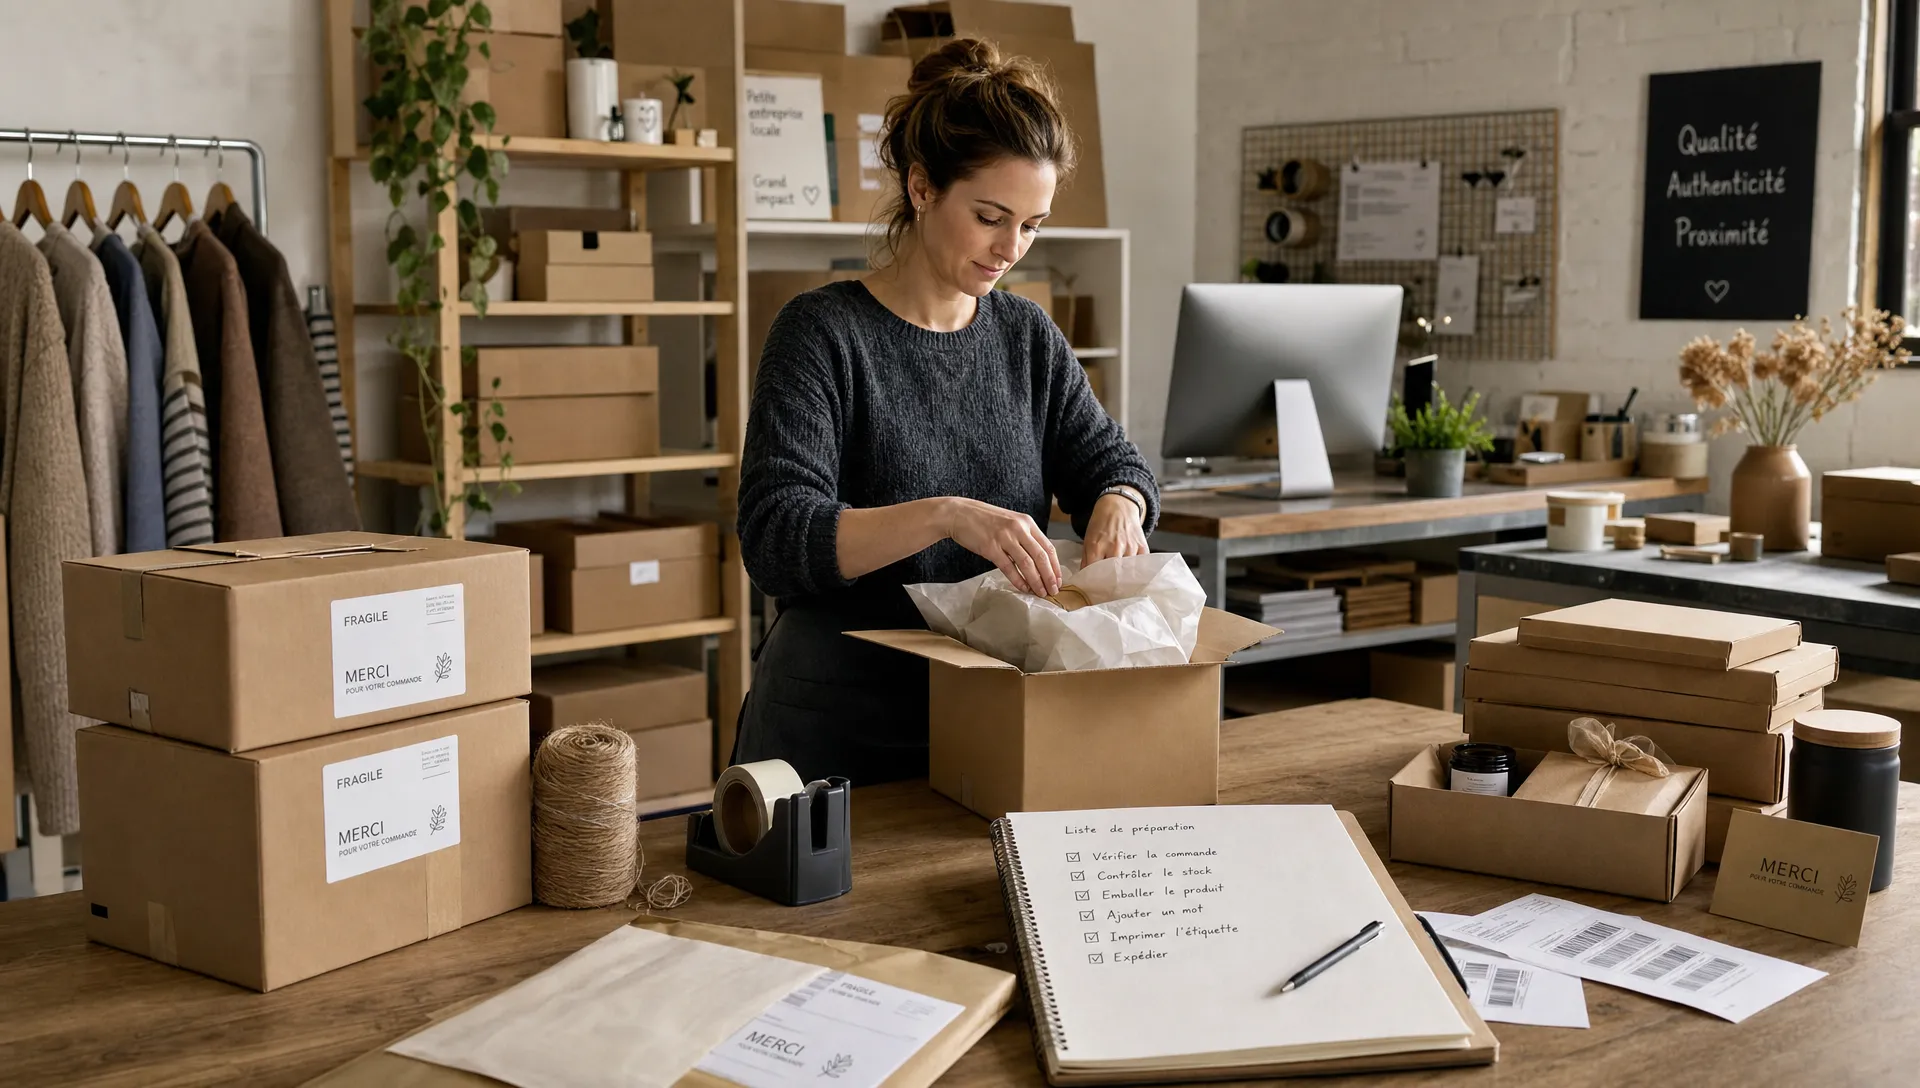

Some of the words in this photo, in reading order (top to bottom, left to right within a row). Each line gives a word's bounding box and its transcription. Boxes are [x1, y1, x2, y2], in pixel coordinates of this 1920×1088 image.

[747, 89, 776, 104] Petite
[748, 108, 803, 121] entreprise
[751, 122, 781, 136] locale
[1678, 121, 1759, 156] Qualité
[752, 174, 787, 188] Grand
[1666, 166, 1786, 198] Authenticité
[755, 192, 795, 208] impact
[1675, 216, 1770, 247] Proximité
[344, 610, 389, 627] FRAGILE
[345, 664, 389, 684] MERCI
[345, 686, 364, 695] POUR
[365, 681, 385, 692] VOTRE
[386, 675, 422, 687] COMMANDE
[336, 768, 383, 789] FRAGILE
[338, 821, 384, 846] MERCI
[1065, 825, 1097, 835] Liste
[1109, 824, 1124, 834] de
[1132, 822, 1195, 836] préparation
[338, 847, 357, 857] POUR
[358, 840, 380, 851] VOTRE
[381, 829, 417, 844] COMMANDE
[1092, 850, 1138, 862] Vérifier
[1147, 850, 1158, 859] la
[1165, 847, 1218, 859] commande
[1097, 869, 1153, 881] Contrôler
[1163, 868, 1174, 877] le
[1182, 866, 1213, 876] stock
[1760, 857, 1818, 884] MERCI
[1102, 888, 1155, 900] Emballer
[1165, 886, 1176, 896] le
[1183, 882, 1225, 898] produit
[1106, 908, 1153, 924] Ajouter
[1161, 909, 1176, 917] un
[1182, 903, 1204, 915] mot
[1110, 930, 1166, 944] Imprimer
[1175, 924, 1239, 939] l'étiquette
[1114, 950, 1169, 964] Expédier
[745, 1031, 805, 1056] MERCI
